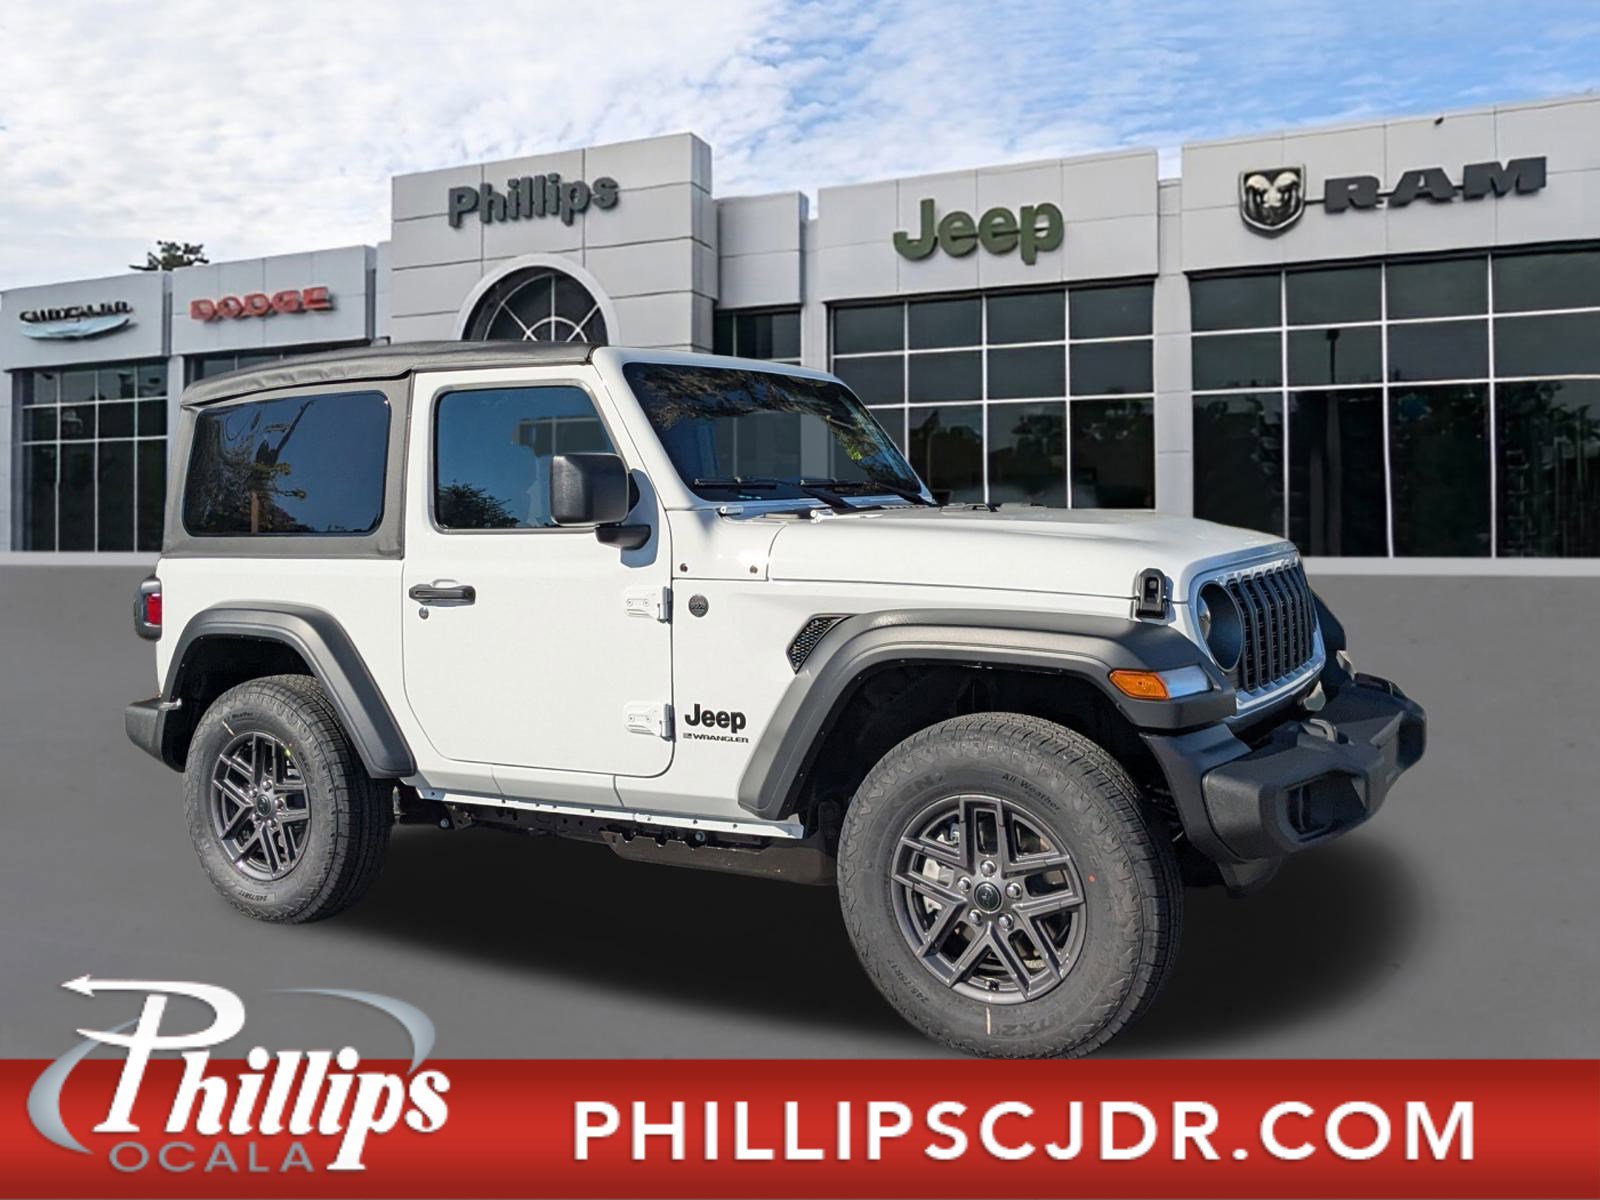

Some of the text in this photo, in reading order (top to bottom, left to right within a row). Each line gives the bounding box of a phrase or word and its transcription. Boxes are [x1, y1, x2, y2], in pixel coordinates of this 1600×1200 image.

[449, 173, 618, 227] Phillips
[1325, 157, 1547, 213] RAM
[893, 199, 1064, 265] Jeep
[190, 286, 332, 321] DODGE
[685, 704, 746, 733] Jeep
[692, 732, 749, 744] WRANGLER
